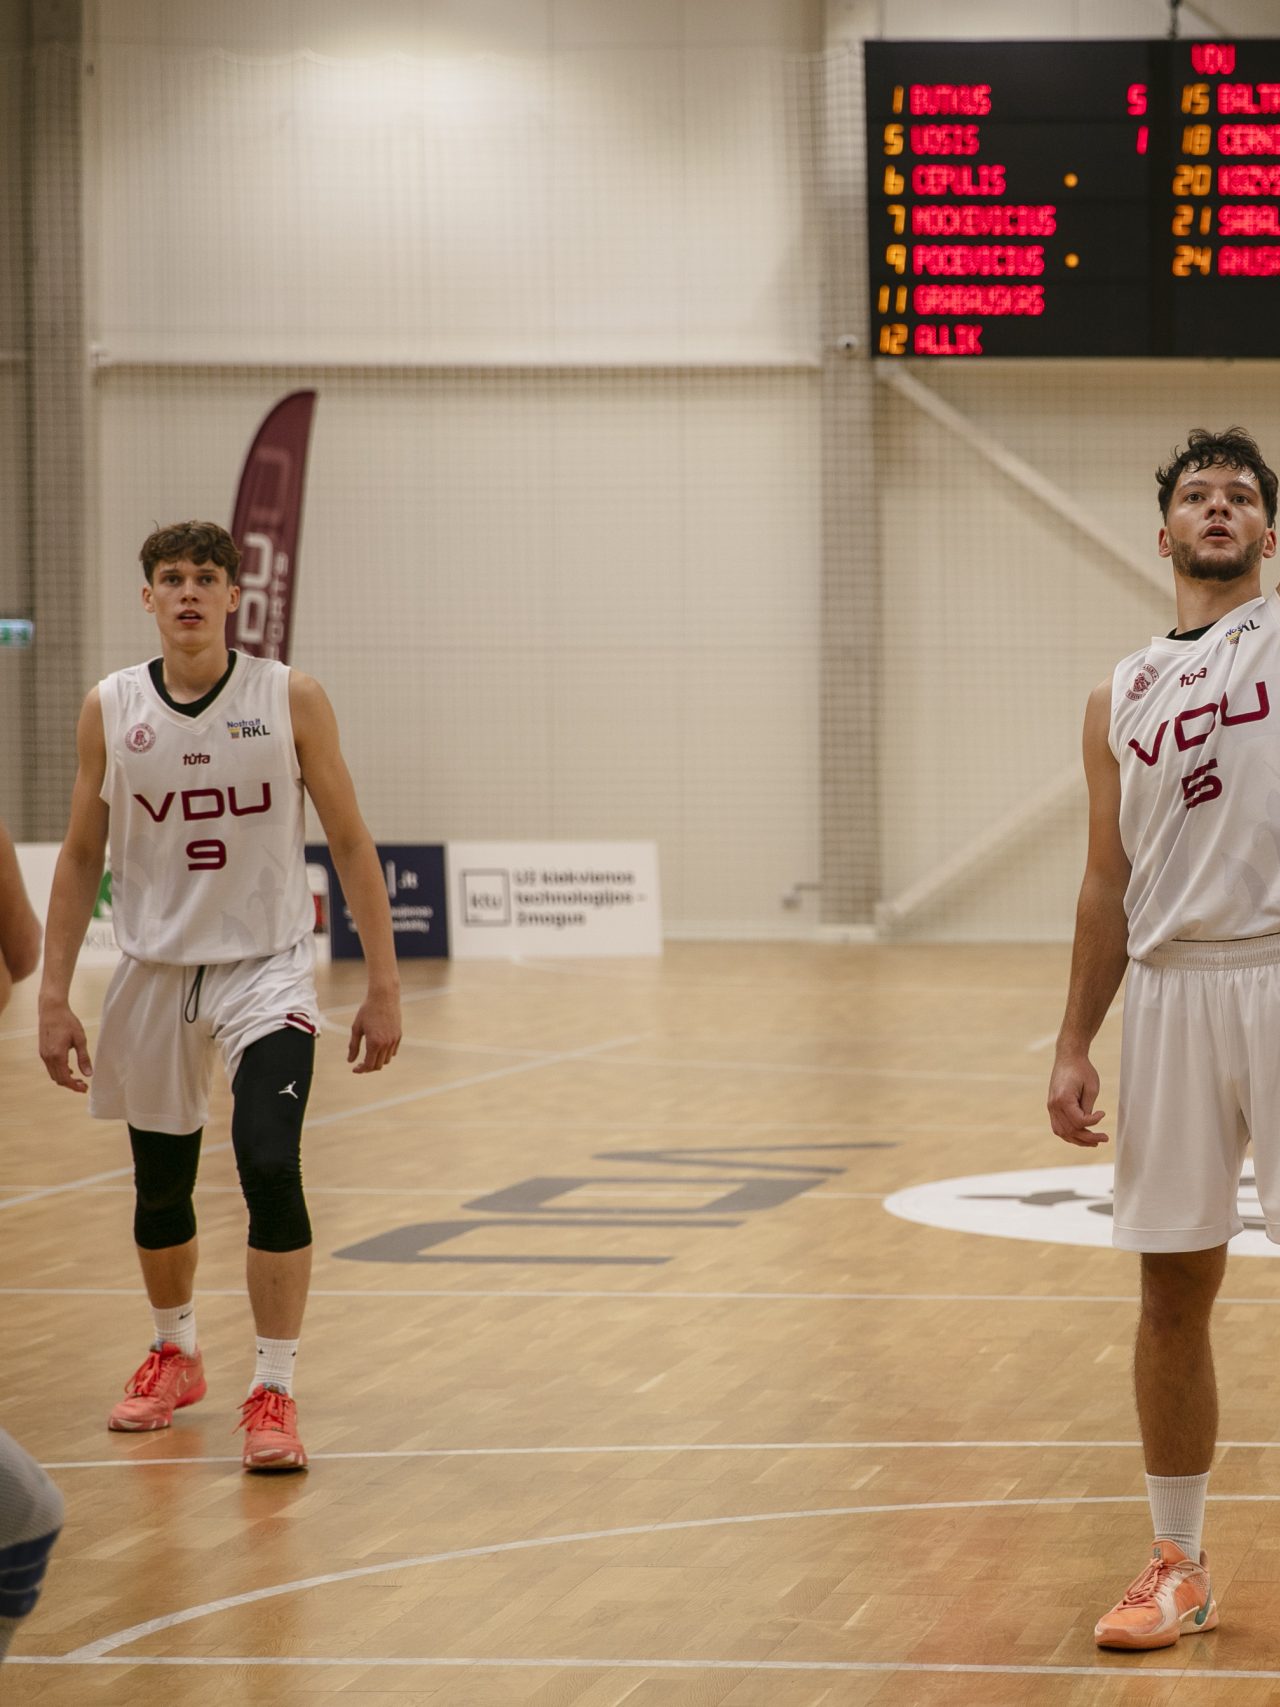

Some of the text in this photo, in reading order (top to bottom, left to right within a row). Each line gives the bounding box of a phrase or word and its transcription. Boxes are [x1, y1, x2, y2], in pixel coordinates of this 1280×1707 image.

[1191, 43, 1236, 75] VDU
[891, 87, 905, 114] 1
[1127, 83, 1147, 116] 5
[1181, 83, 1210, 115] 15
[884, 123, 904, 156] 5
[1135, 125, 1150, 156] 1
[1182, 124, 1212, 156] 18
[884, 166, 905, 195] 6
[1172, 165, 1212, 196] 20
[888, 204, 906, 234] 7
[1172, 204, 1212, 236] 21
[885, 244, 907, 274] 9
[1172, 245, 1212, 277] 24
[878, 286, 908, 313] 11
[879, 323, 908, 355] 12
[242, 725, 271, 738] RKL
[1127, 681, 1270, 767] VDU
[1181, 758, 1223, 809] 5
[133, 782, 272, 823] VDU
[185, 838, 227, 871] 9
[514, 888, 635, 910] technologijos
